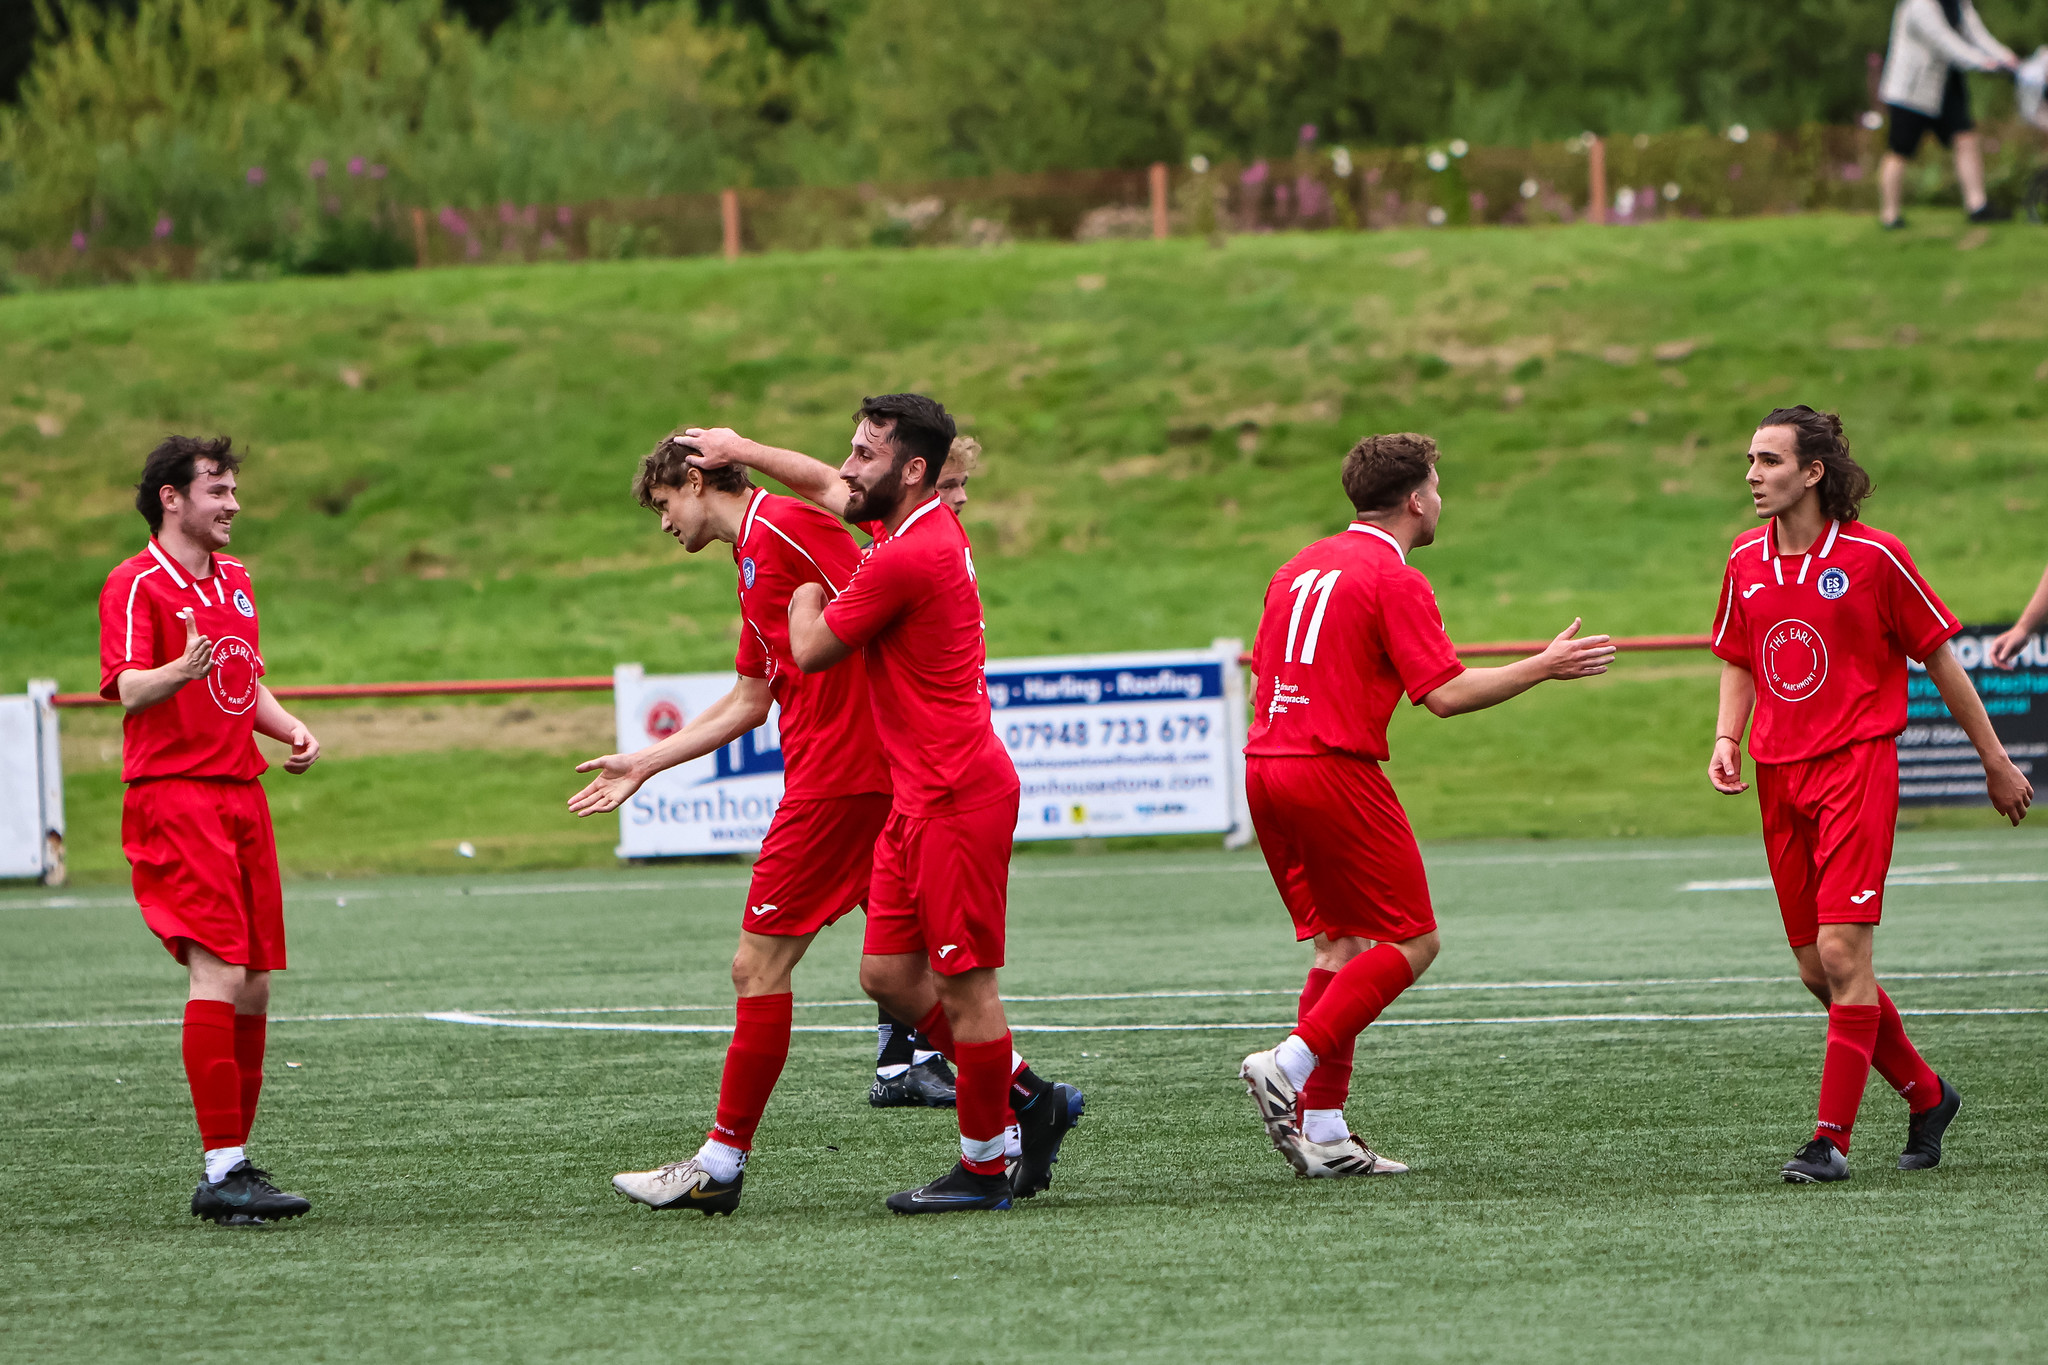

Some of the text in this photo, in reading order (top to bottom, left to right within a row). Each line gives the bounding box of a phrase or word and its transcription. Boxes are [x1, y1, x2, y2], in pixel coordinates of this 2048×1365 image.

[1826, 577, 1840, 589] ES
[1285, 569, 1342, 664] 11
[1769, 628, 1813, 651] THE EARL
[215, 644, 251, 668] THE EARL
[1116, 669, 1202, 698] Roofing
[1773, 672, 1816, 691] OF MARCHMONT
[1006, 715, 1210, 749] 07948 733 679
